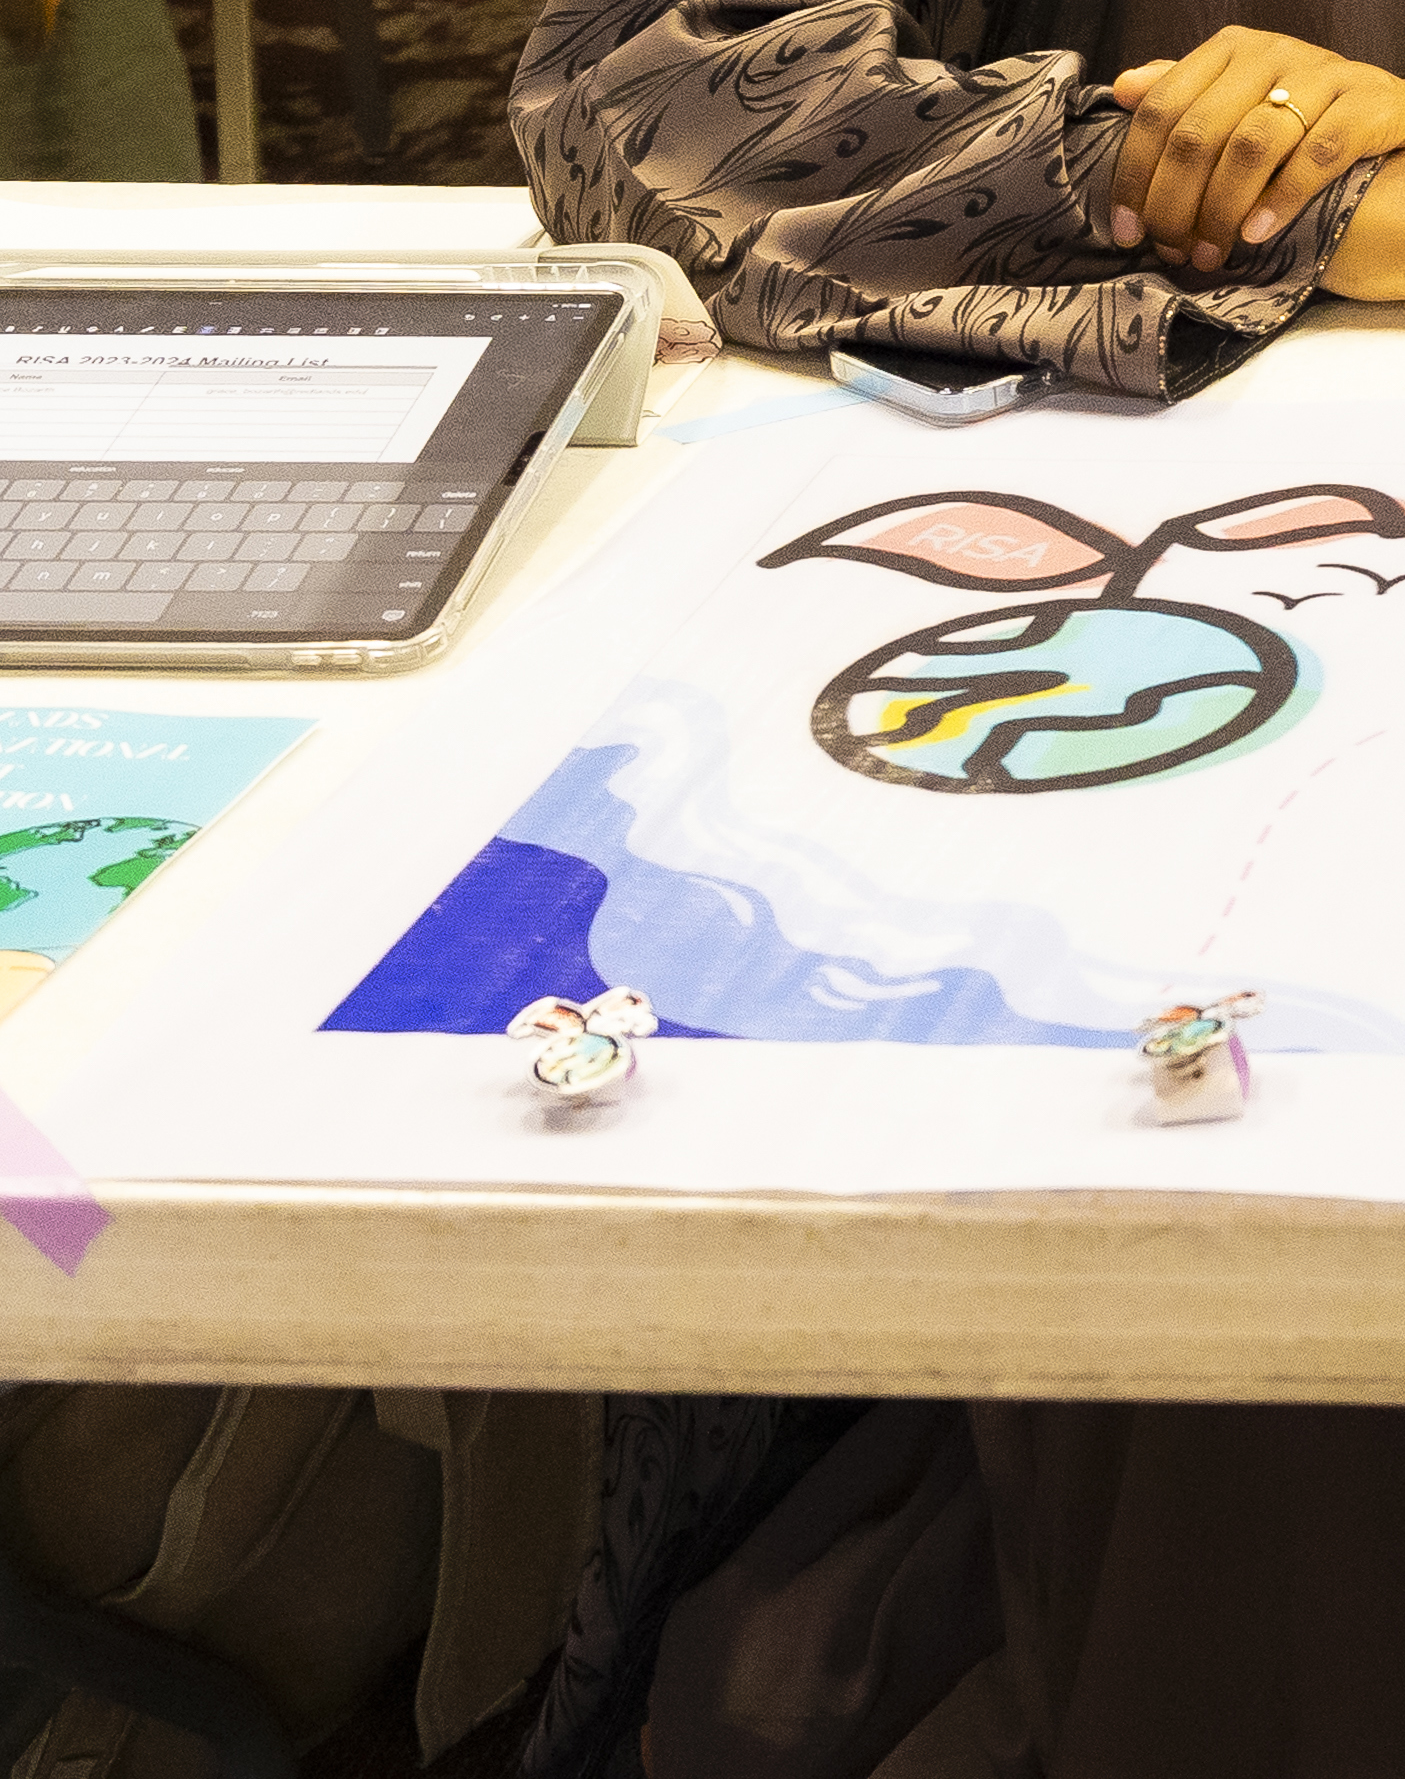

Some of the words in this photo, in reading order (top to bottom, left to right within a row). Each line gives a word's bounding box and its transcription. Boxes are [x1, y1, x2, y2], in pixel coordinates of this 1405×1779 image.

[16, 355, 70, 365] RISA
[199, 357, 280, 369] Mailing
[286, 358, 330, 367] List
[9, 373, 43, 381] Name
[907, 522, 1050, 569] RISA
